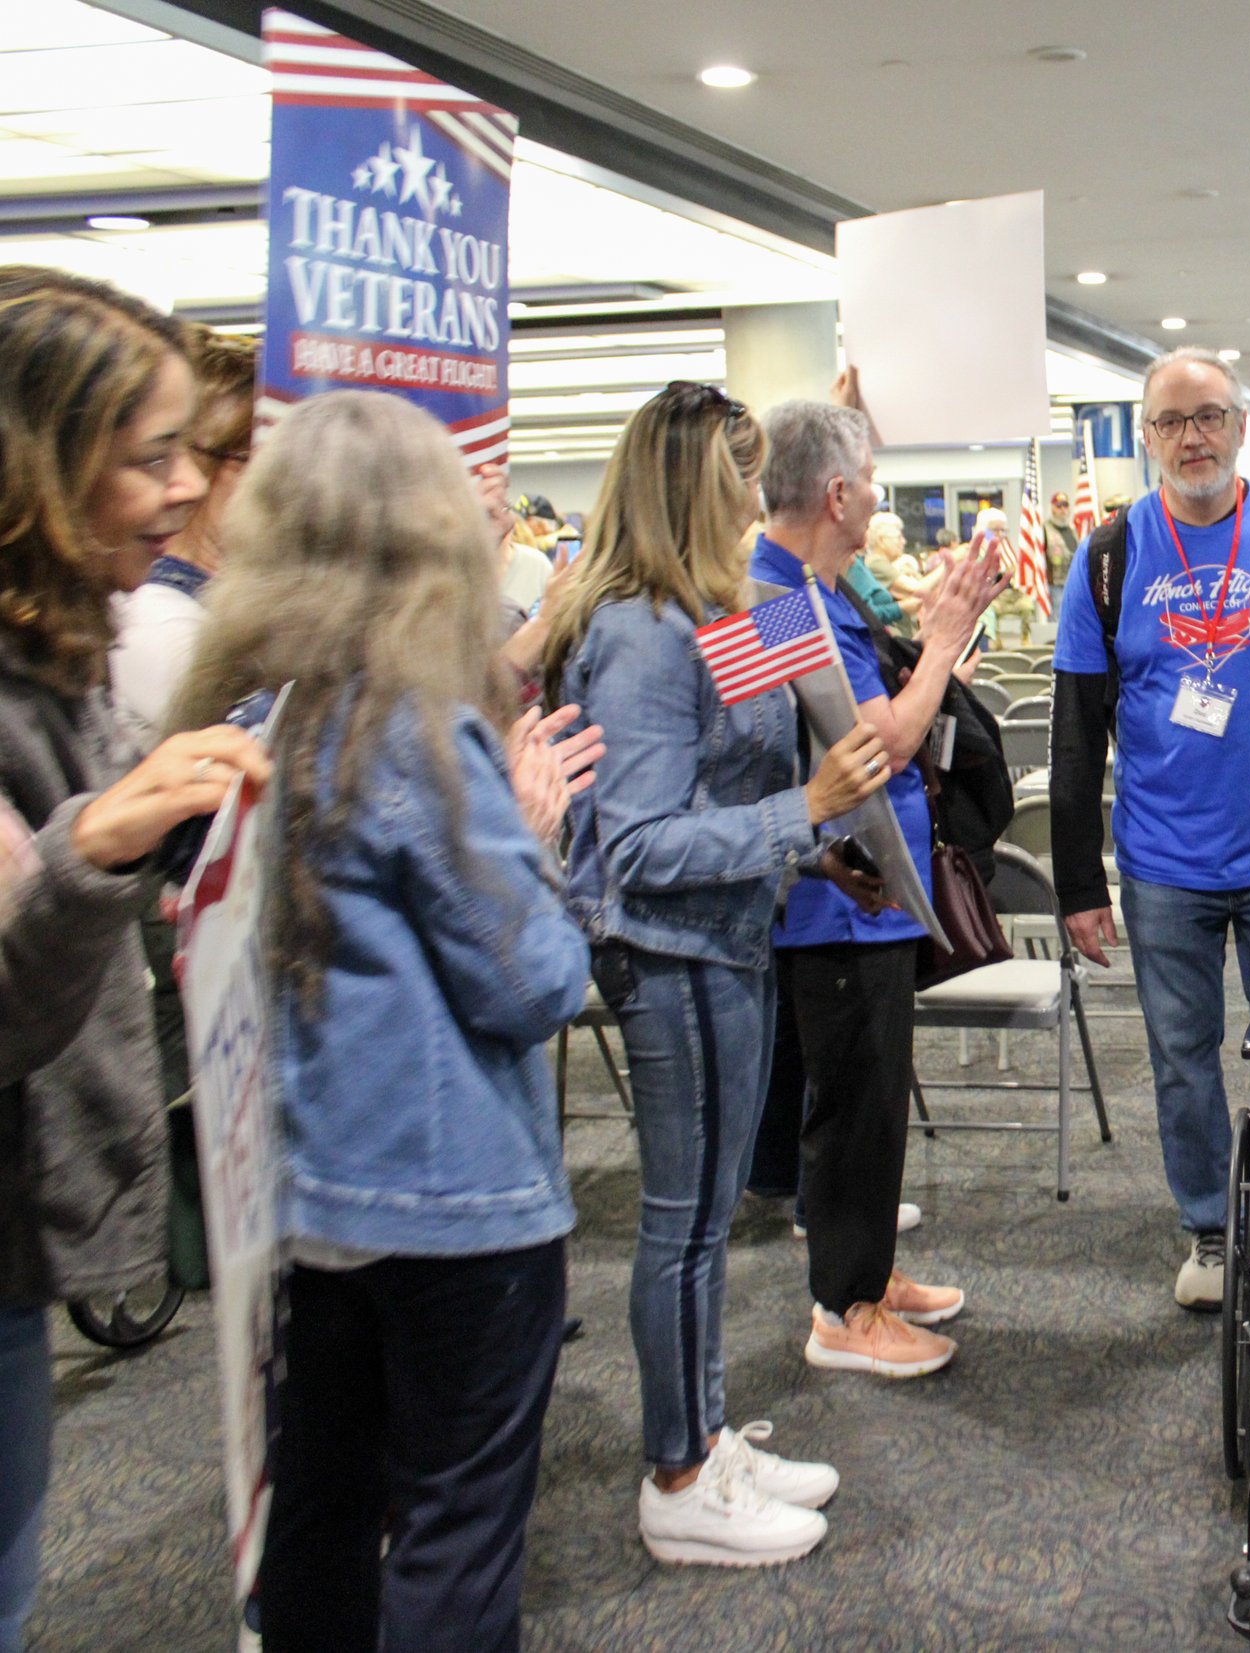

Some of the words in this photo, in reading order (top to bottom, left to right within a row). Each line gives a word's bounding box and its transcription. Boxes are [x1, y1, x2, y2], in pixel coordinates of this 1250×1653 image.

[282, 186, 440, 276] THANK
[439, 228, 500, 290] YOU
[284, 255, 500, 352] VETERANS
[294, 338, 355, 374] HAVE
[356, 348, 375, 378] A
[375, 350, 439, 384] GREAT
[1142, 573, 1203, 606] Honor
